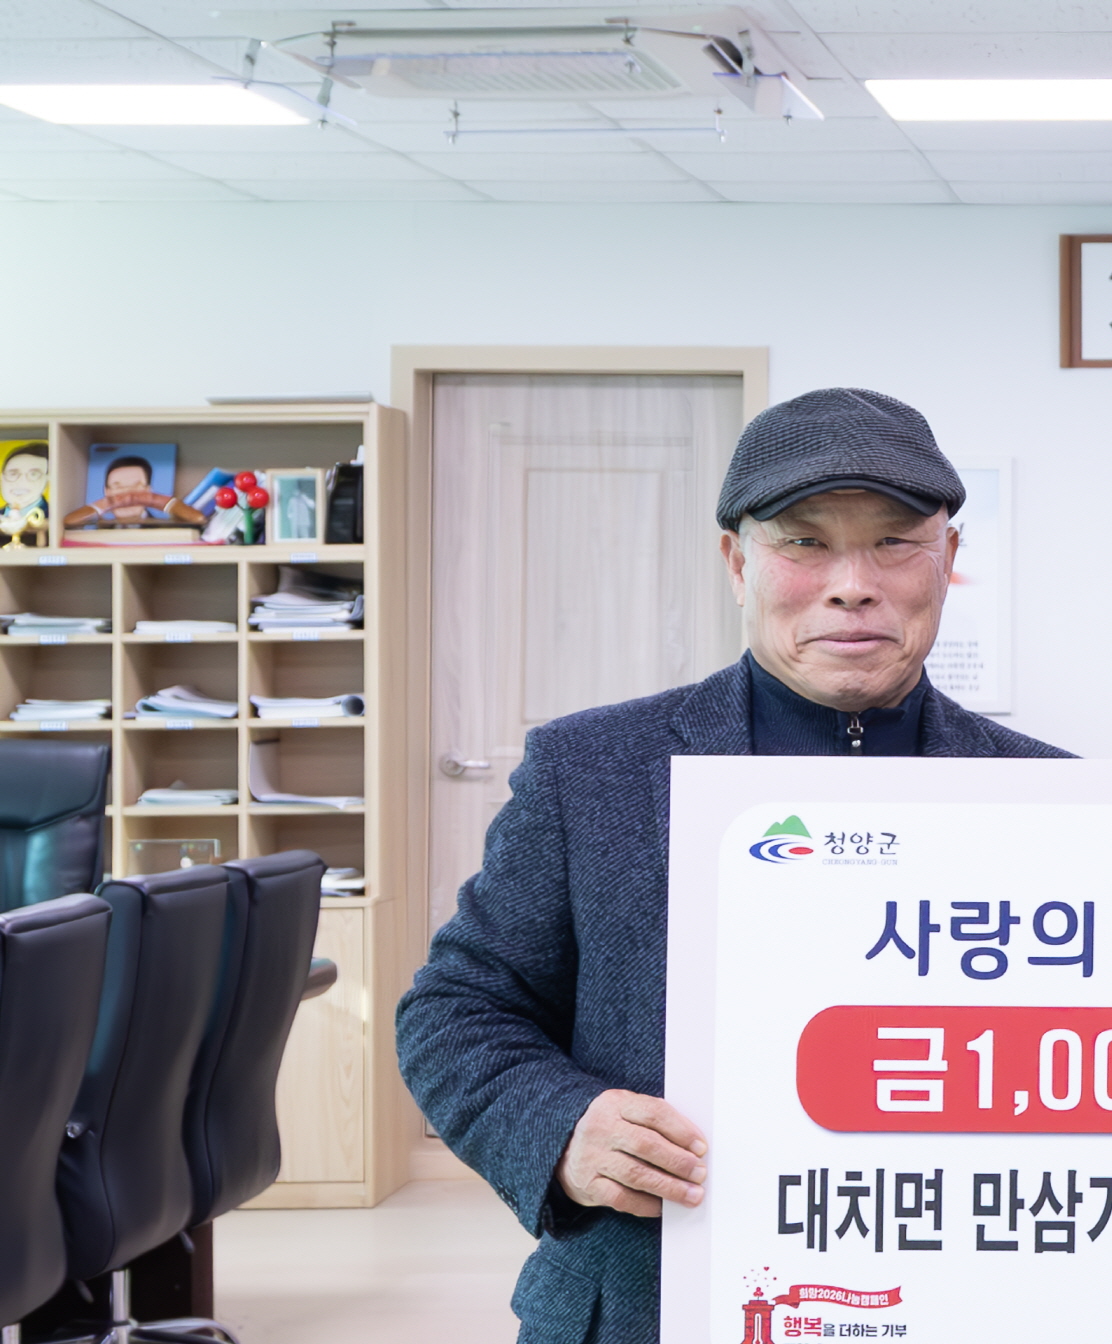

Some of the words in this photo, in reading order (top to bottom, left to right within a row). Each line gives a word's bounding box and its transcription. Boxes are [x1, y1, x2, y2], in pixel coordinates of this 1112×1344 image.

[825, 831, 900, 855] 청양군
[865, 899, 1095, 981] 사랑의
[777, 1167, 944, 1253] 대치면
[799, 1286, 890, 1307] 희망2026나눔캠페인
[783, 1315, 836, 1338] 행복을
[839, 1322, 878, 1338] 더하는
[881, 1324, 907, 1338] 기부
